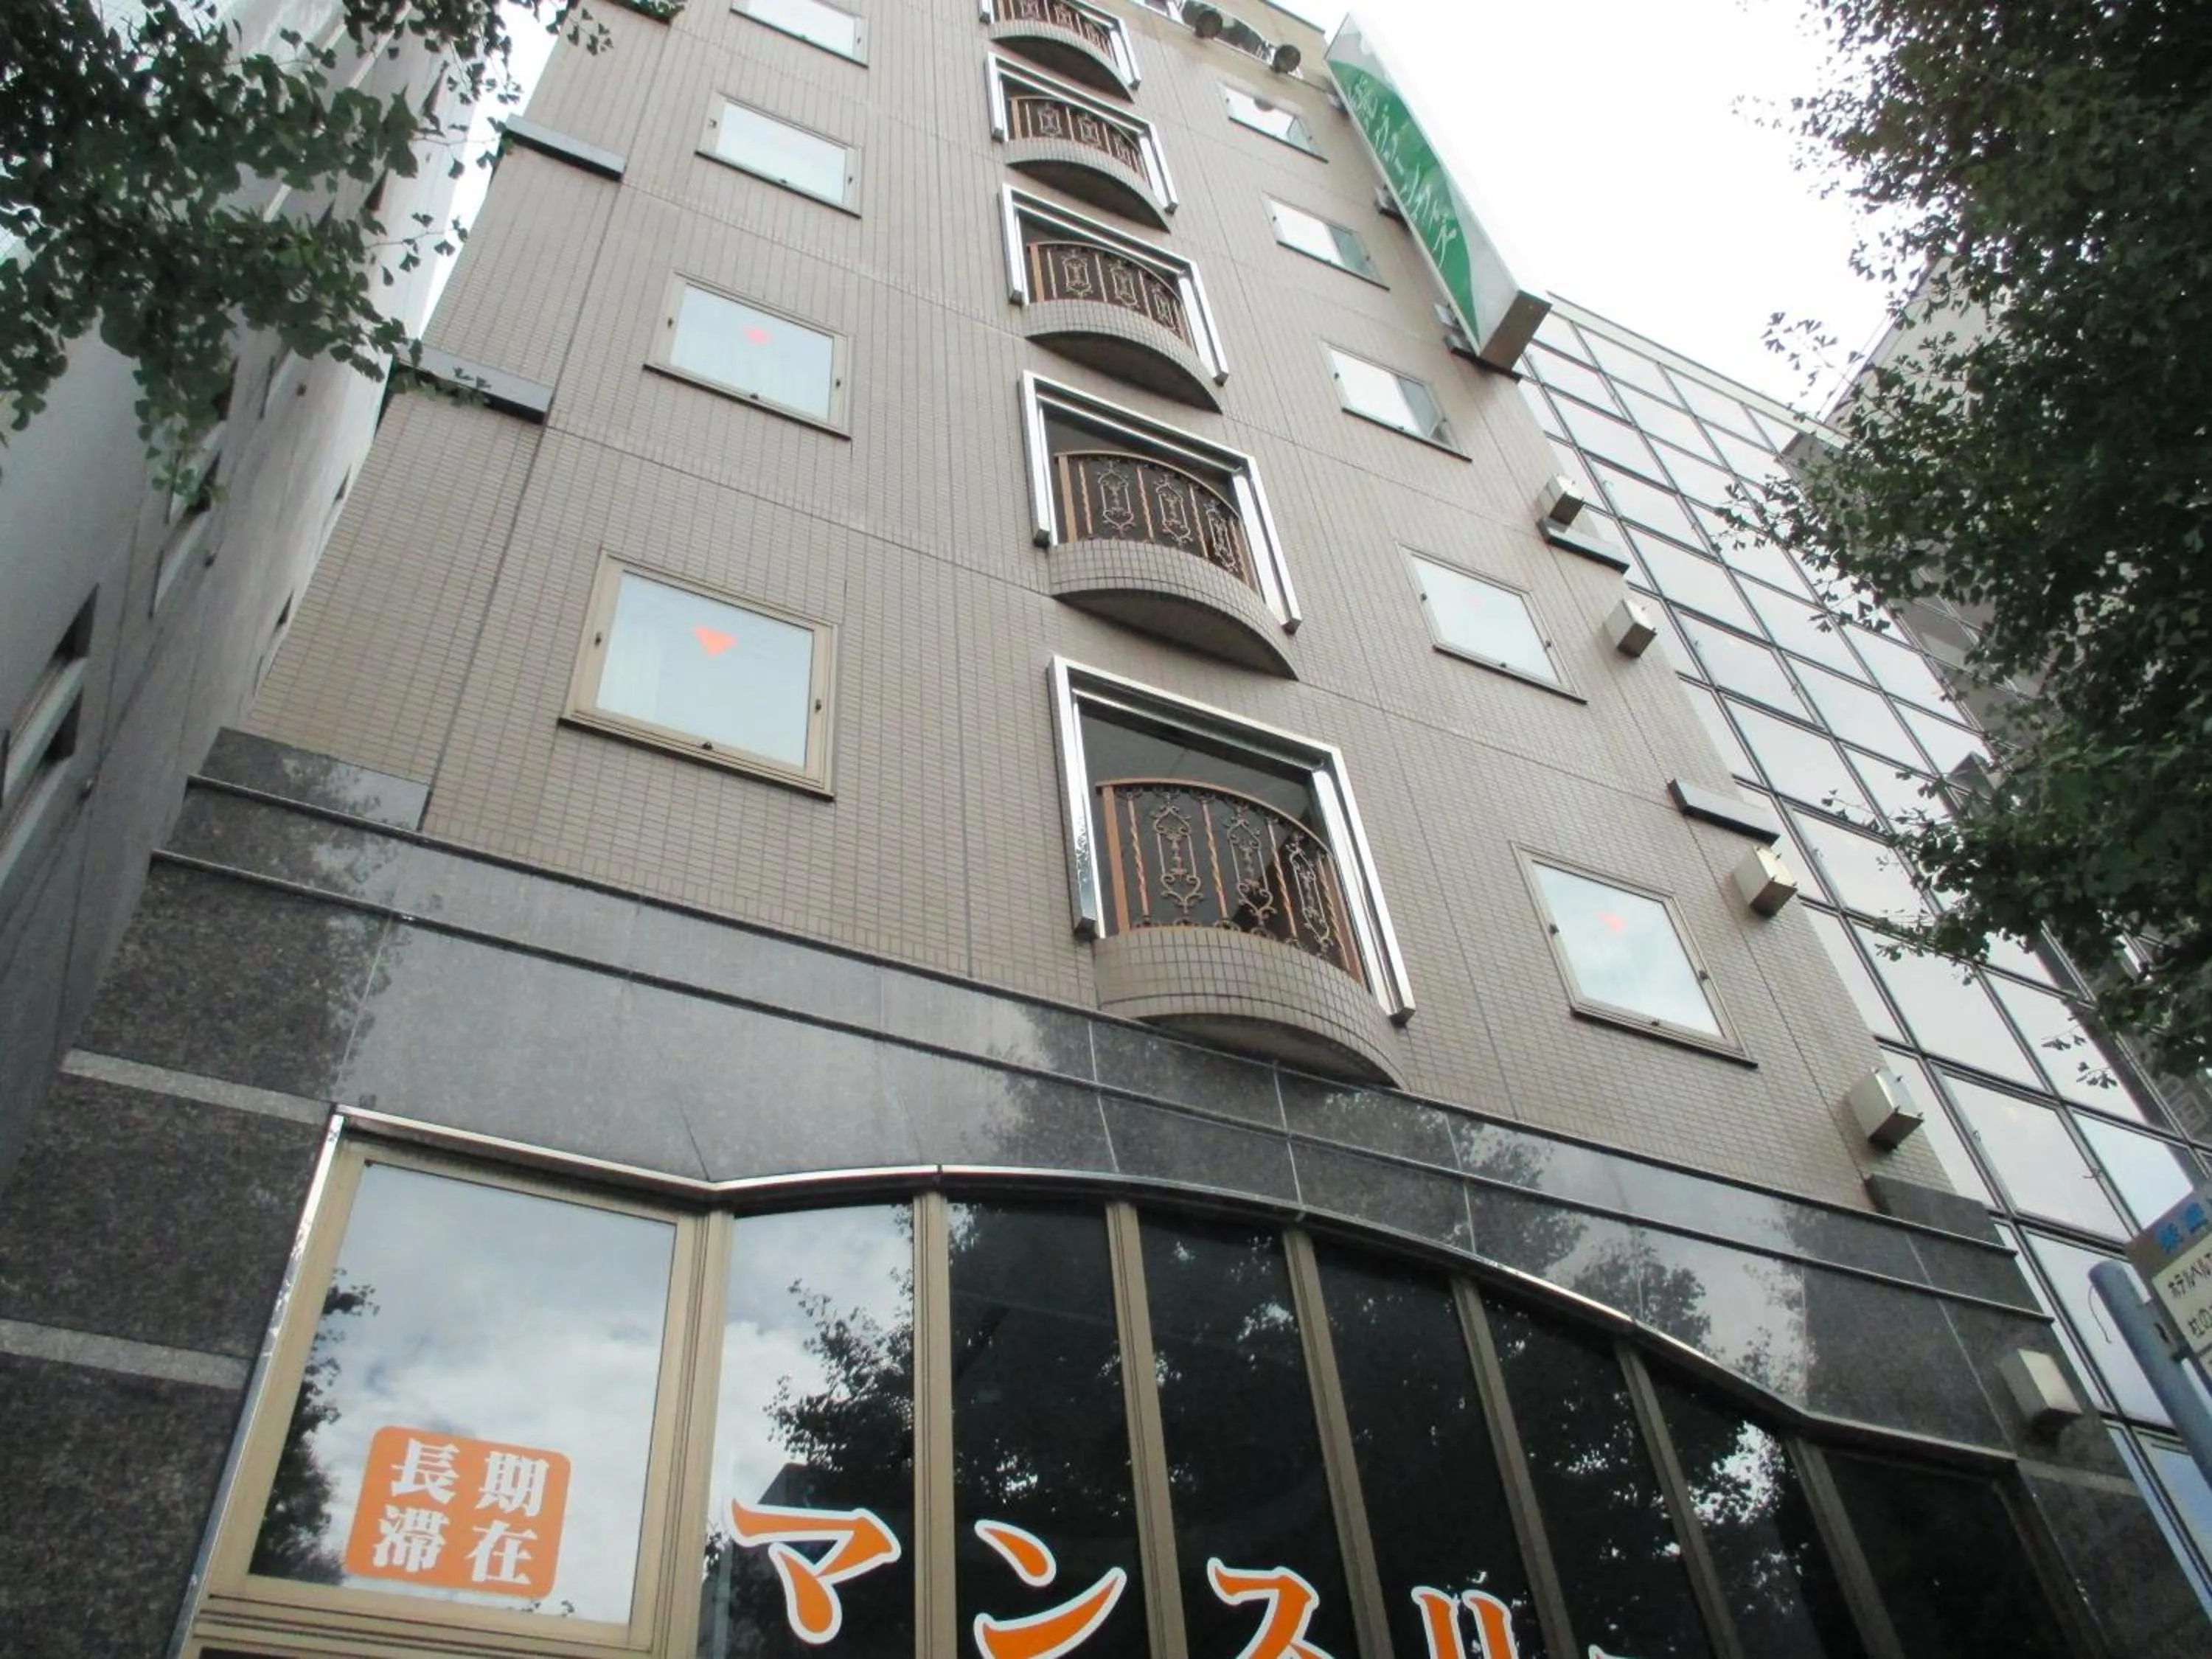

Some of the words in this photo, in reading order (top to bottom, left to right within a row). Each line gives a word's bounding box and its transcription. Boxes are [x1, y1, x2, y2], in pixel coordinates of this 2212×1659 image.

[390, 1438, 549, 1517] 長期
[372, 1504, 539, 1586] 滞在
[724, 1498, 1631, 1659] マンスリ
